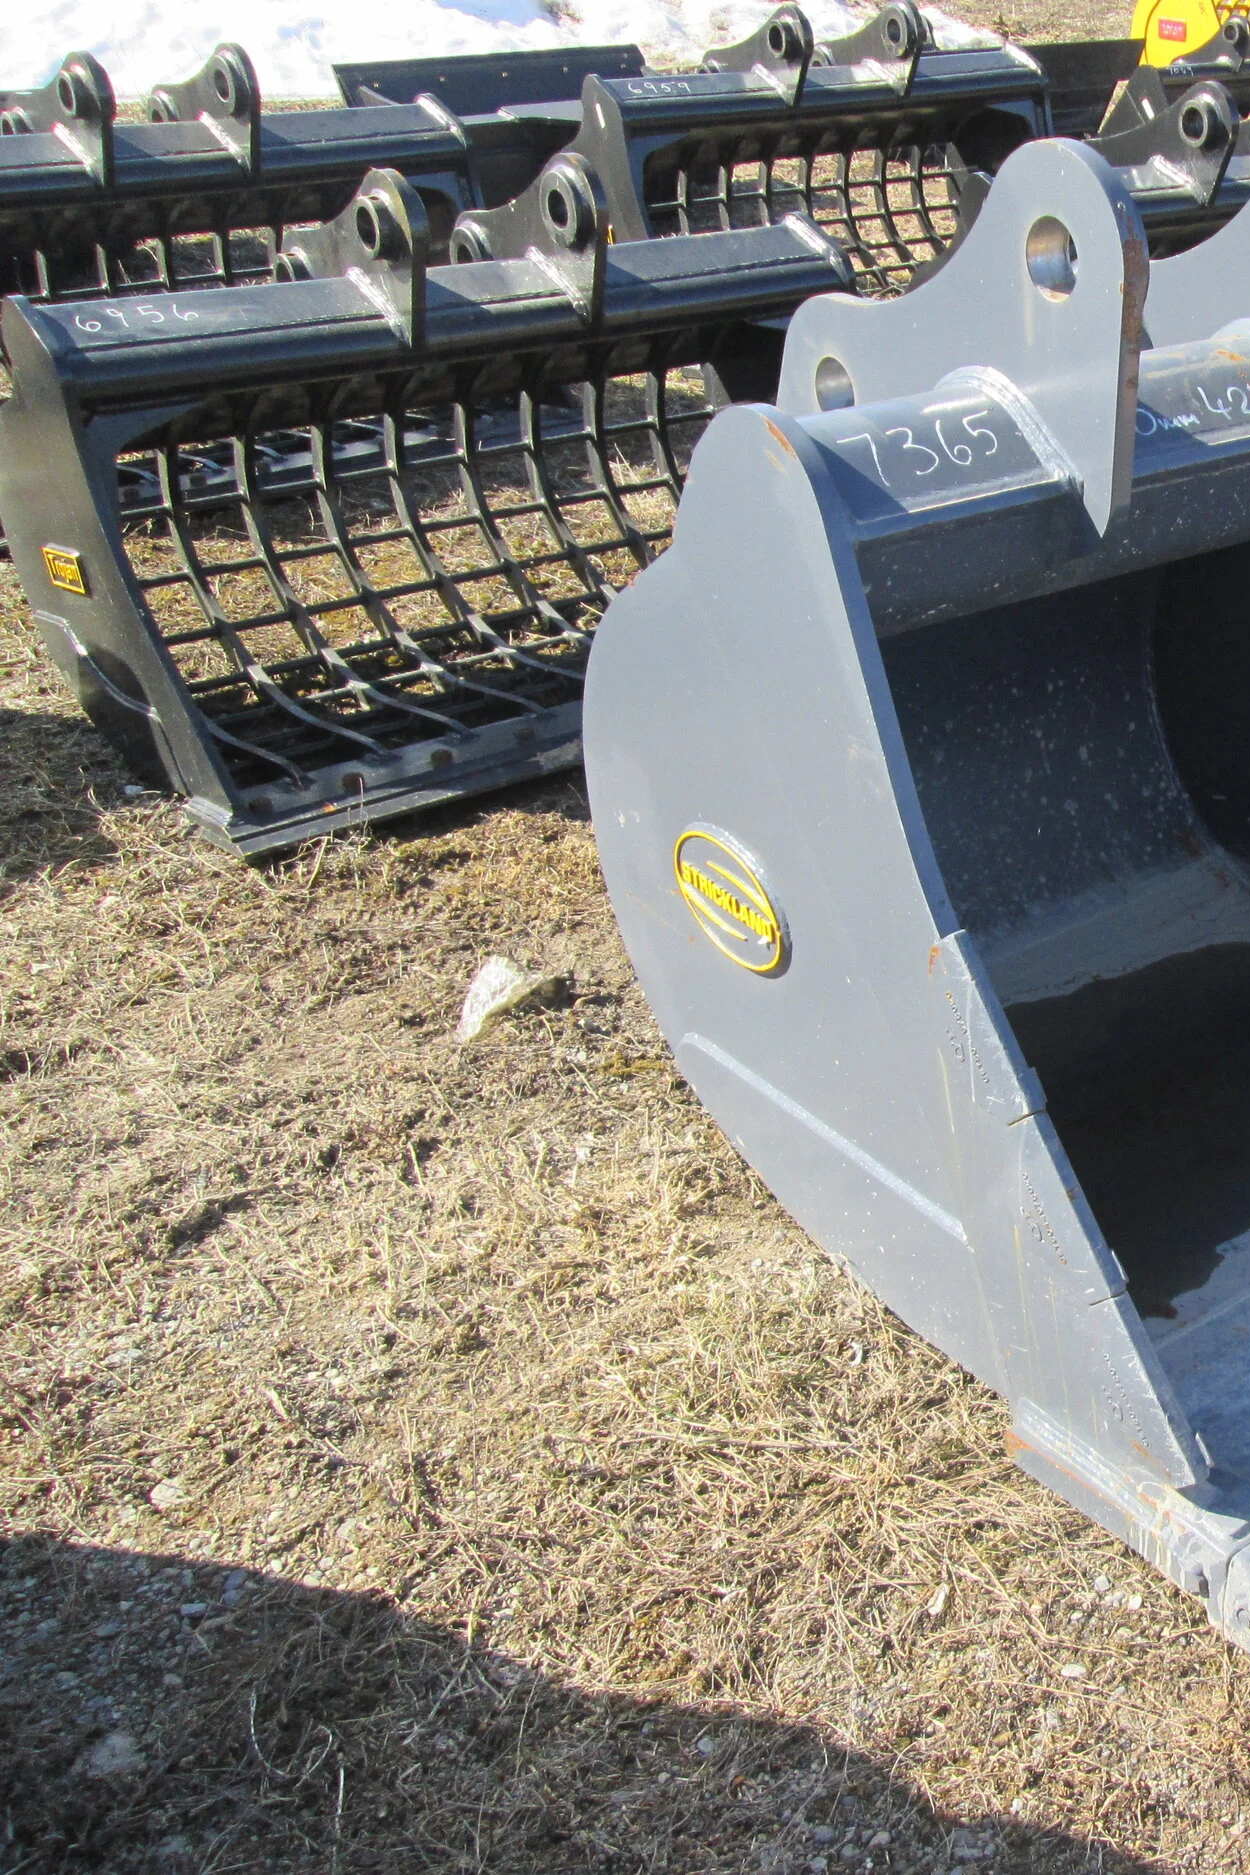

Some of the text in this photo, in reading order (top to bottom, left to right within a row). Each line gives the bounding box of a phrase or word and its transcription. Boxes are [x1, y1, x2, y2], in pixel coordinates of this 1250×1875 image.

[627, 81, 692, 94] 6959
[75, 303, 199, 332] 6956
[836, 410, 998, 487] 7365
[47, 553, 79, 584] Trojan
[680, 860, 776, 944] STRICKLAND
